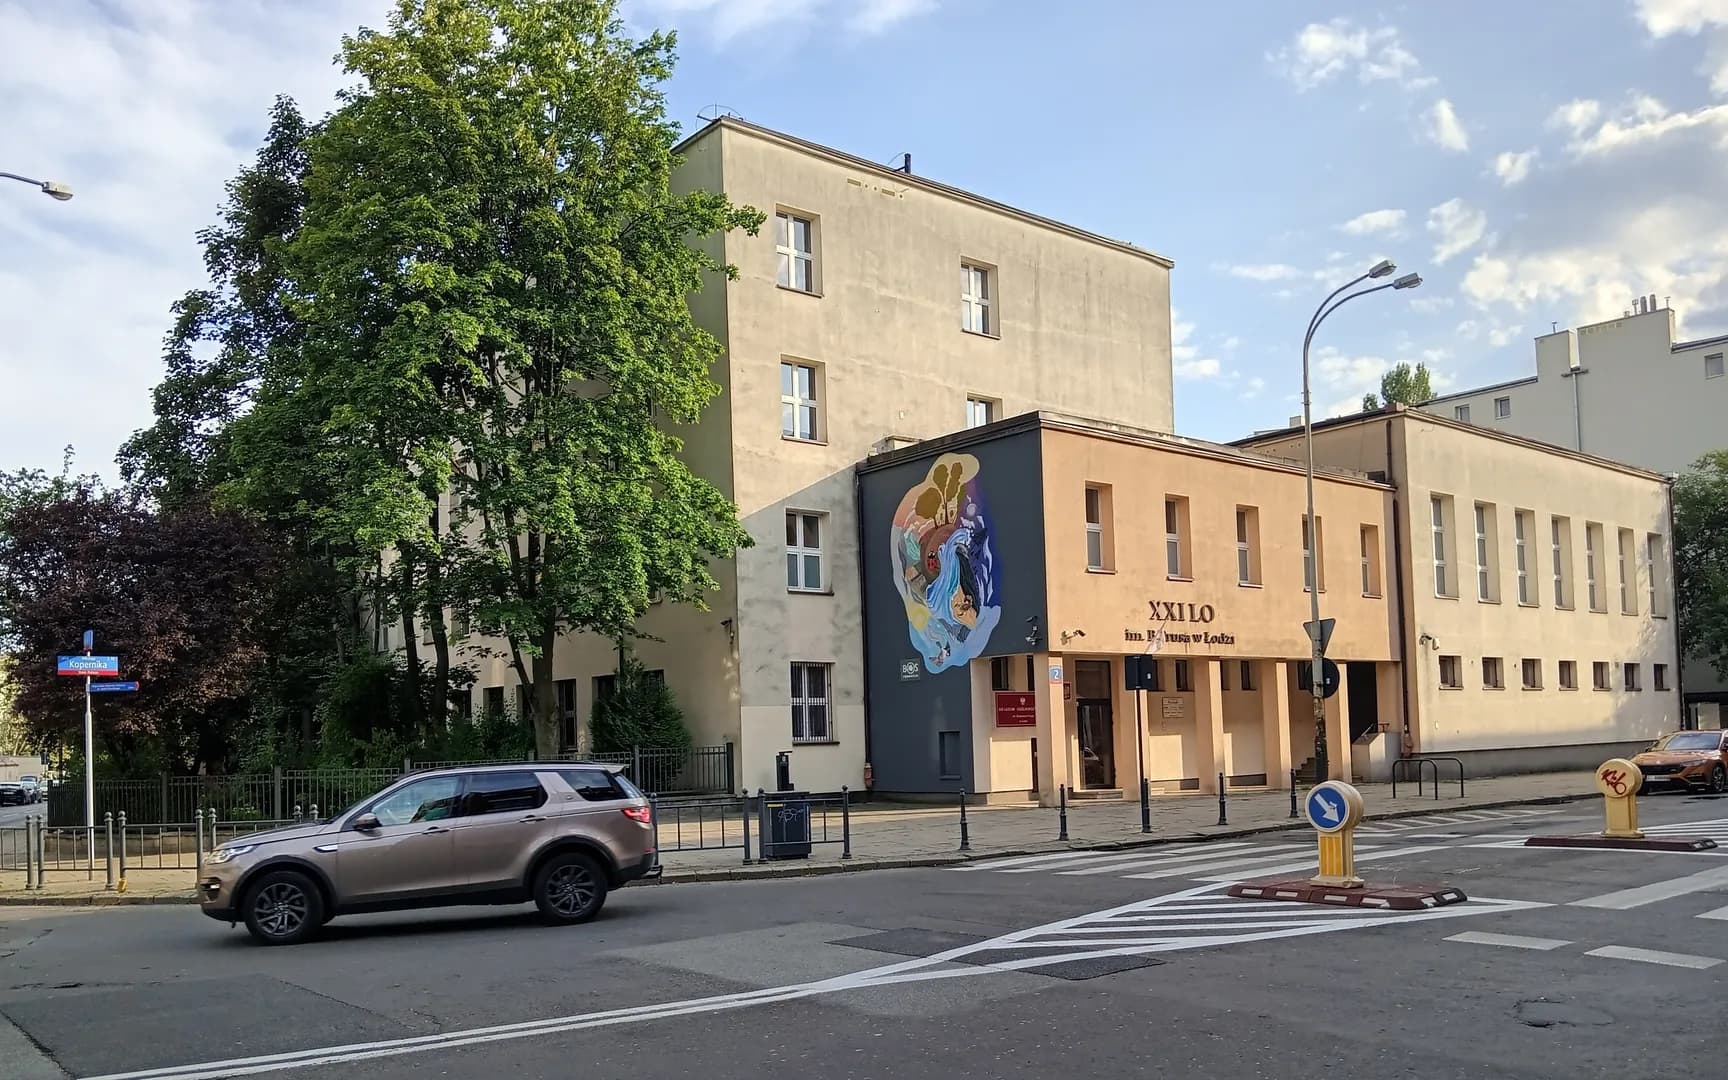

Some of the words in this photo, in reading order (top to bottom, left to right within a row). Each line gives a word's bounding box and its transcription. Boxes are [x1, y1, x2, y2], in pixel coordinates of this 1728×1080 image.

[1149, 600, 1186, 622] XXI
[1188, 603, 1215, 623] LO
[1192, 633, 1202, 643] w
[69, 661, 107, 669] Kopernika
[1053, 669, 1059, 680] 2
